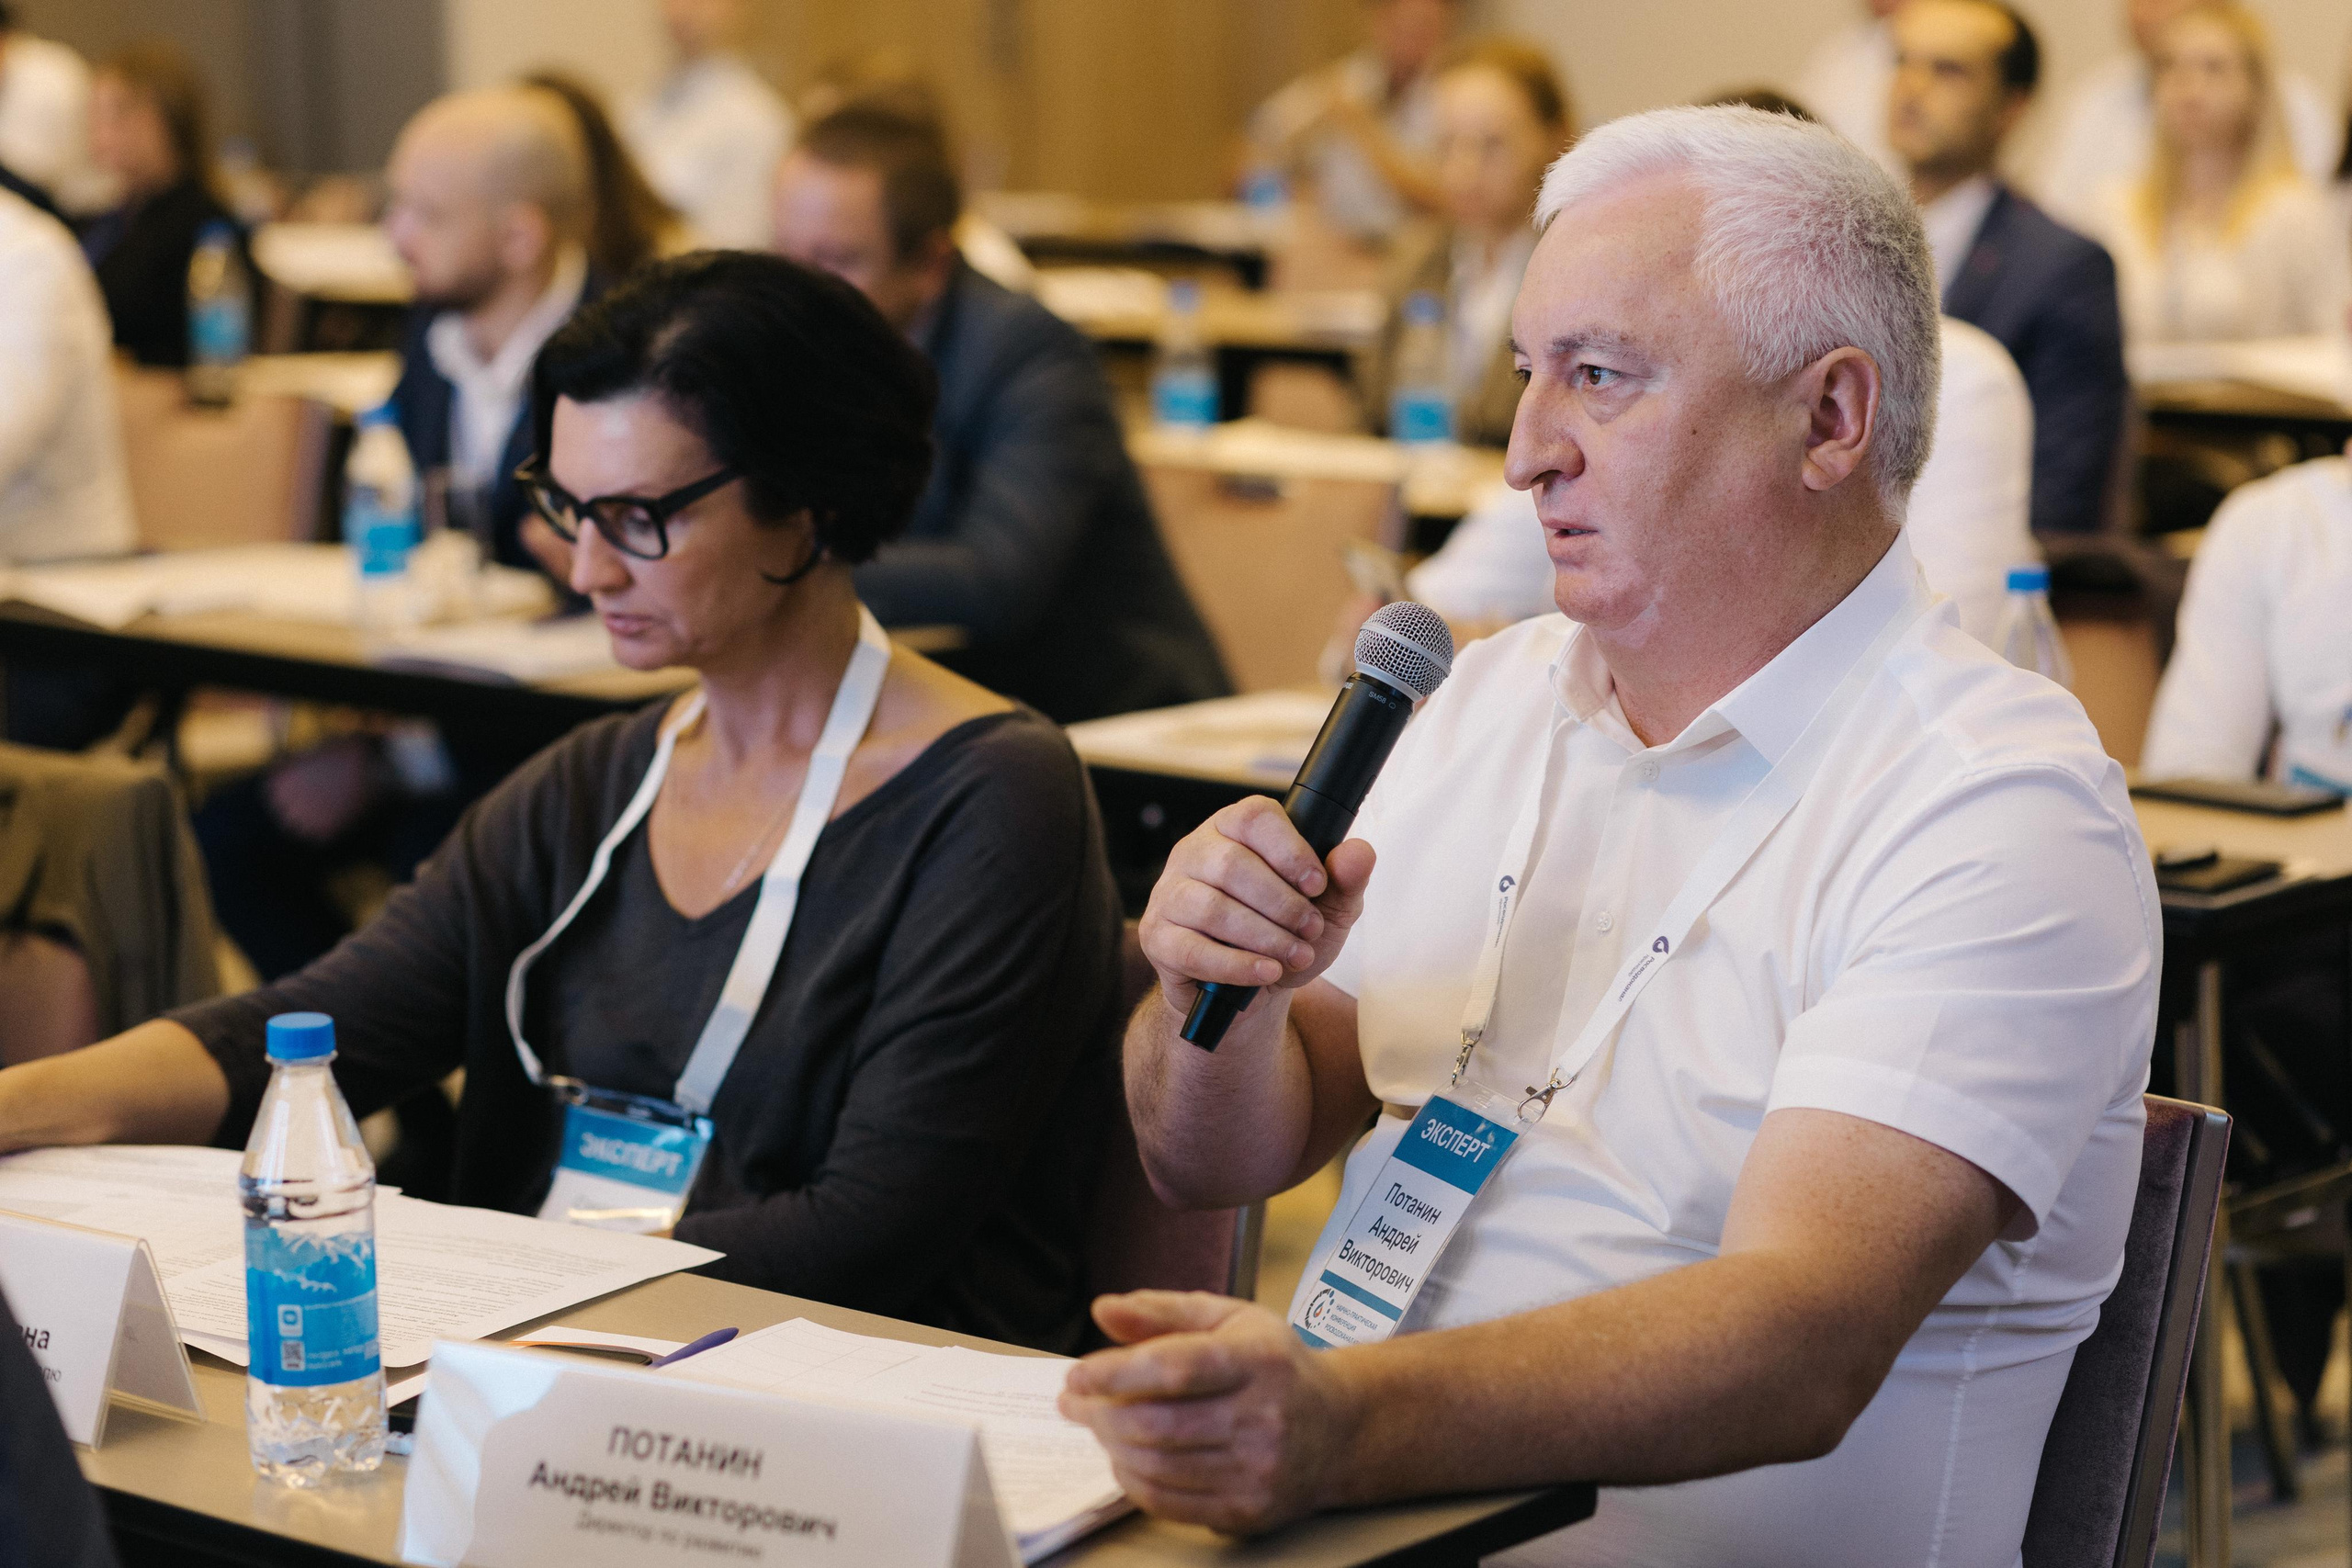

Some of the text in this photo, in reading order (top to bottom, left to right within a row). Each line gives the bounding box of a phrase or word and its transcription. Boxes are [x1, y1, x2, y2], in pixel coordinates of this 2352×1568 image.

[1368, 691, 1387, 705] SM58
[1618, 955, 1656, 1003] Росводоканал
[578, 1131, 684, 1178] ЭКСПЕРТ
[1420, 1118, 1491, 1164] ЭКСПЕРТ
[1384, 1181, 1442, 1225] Потанин
[1367, 1214, 1421, 1255] Андрей
[1338, 1237, 1415, 1294] Викторович
[1329, 1314, 1357, 1332] КОНФЕРЕНЦИЯ
[1335, 1304, 1378, 1331] НАУЧНО-ПРАКТИЧЕСКАЯ
[607, 1425, 764, 1481] ПОТАНИН
[527, 1459, 838, 1540] Андрей Викторович
